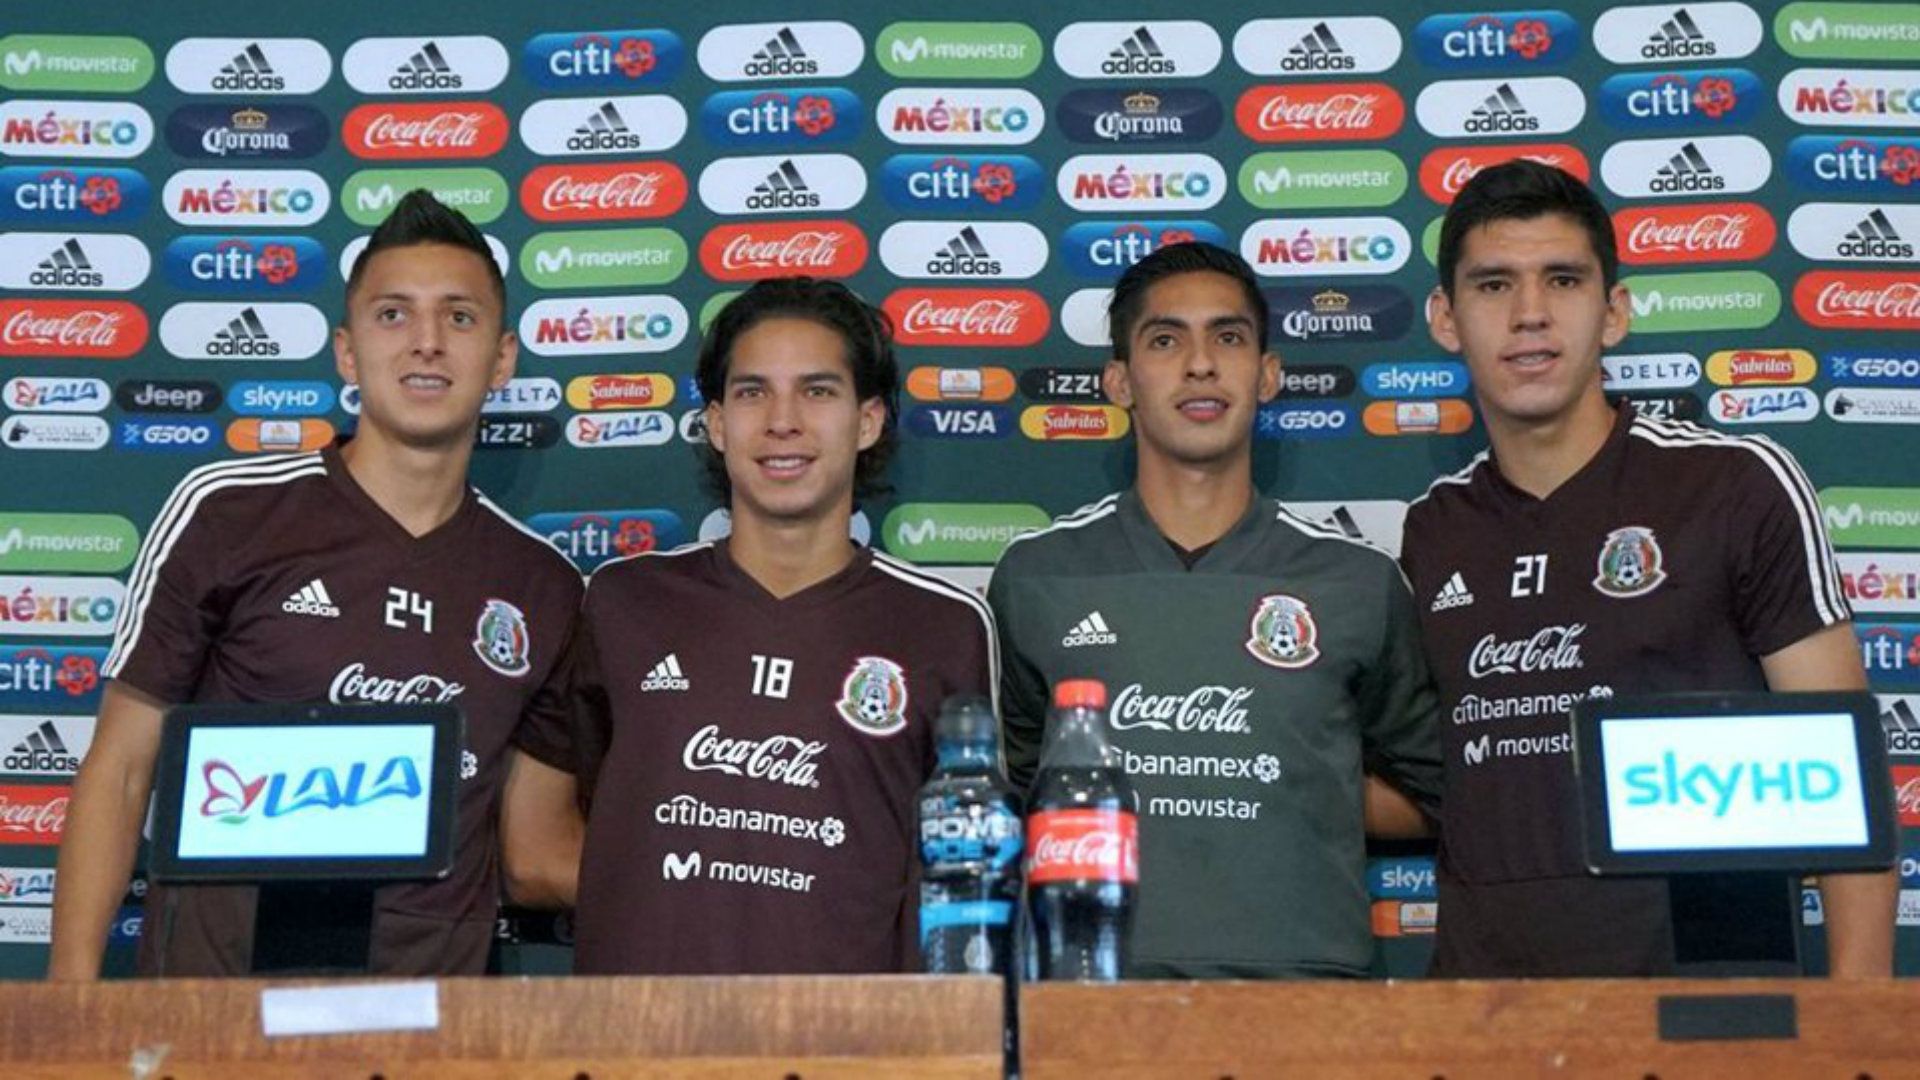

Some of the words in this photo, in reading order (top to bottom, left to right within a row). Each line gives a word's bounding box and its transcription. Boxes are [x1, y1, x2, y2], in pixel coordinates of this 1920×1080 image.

[1443, 24, 1505, 57] citi
[1834, 23, 1919, 41] movista
[549, 43, 611, 77] citi
[933, 41, 1027, 59] movistar
[1641, 38, 1716, 59] adidas
[46, 56, 140, 74] movistar
[744, 56, 818, 77] adidas
[1101, 55, 1175, 75] adidas
[1280, 52, 1355, 71] adidas
[212, 72, 285, 91] adidas
[389, 72, 462, 90] adidas
[1627, 82, 1690, 117] citi
[727, 99, 789, 134] citi
[1258, 94, 1380, 131] Coca-Cola
[1464, 111, 1539, 132] adidas
[363, 113, 483, 149] Coca-Cola
[1094, 111, 1184, 141] Corona
[202, 126, 290, 157] Corona
[566, 131, 640, 151] adidas
[1814, 146, 1877, 182] citi
[542, 172, 664, 211] Coca-Cola
[908, 166, 970, 199] citi
[1299, 170, 1392, 189] movistar
[1649, 172, 1725, 193] adidas
[15, 178, 77, 211] citi
[746, 189, 820, 209] adidas
[1628, 213, 1751, 252] Coca-Cola
[576, 247, 674, 267] movistar
[721, 232, 843, 270] Coca-Cola
[1837, 236, 1914, 258] adidas
[191, 245, 253, 281] citi
[927, 255, 1002, 275] adidas
[30, 267, 103, 287] adidas
[1669, 289, 1765, 311] movistar
[3, 309, 124, 347] Coca-Cola
[903, 298, 1027, 335] Coca-Cola
[1282, 309, 1374, 341] Corona
[206, 336, 281, 356] adidas
[1620, 362, 1699, 380] DELTA
[1729, 356, 1794, 374] Sabritas
[135, 384, 204, 410] Jeep
[589, 383, 652, 400] Sabritas
[929, 410, 997, 433] VISA
[1043, 413, 1107, 429] Sabritas
[27, 533, 124, 553] movistar
[1510, 554, 1549, 598] 21
[282, 600, 341, 618] adidas
[385, 586, 433, 634] 24
[1431, 593, 1474, 612] adidas
[1062, 631, 1118, 648] adidas
[1468, 622, 1587, 679] Coca-Cola
[1864, 633, 1903, 670] iti
[640, 675, 690, 692] adidas
[751, 654, 794, 699] 18
[1109, 683, 1255, 734] Coca-Cola
[682, 724, 828, 788] Coca-Cola
[1496, 732, 1575, 756] movist
[4, 749, 80, 771] adidas
[1124, 750, 1253, 779] banamex
[262, 755, 422, 818] LALA
[655, 795, 819, 841] citibanamex
[1149, 796, 1261, 820] movistar
[708, 860, 816, 893] movistar
